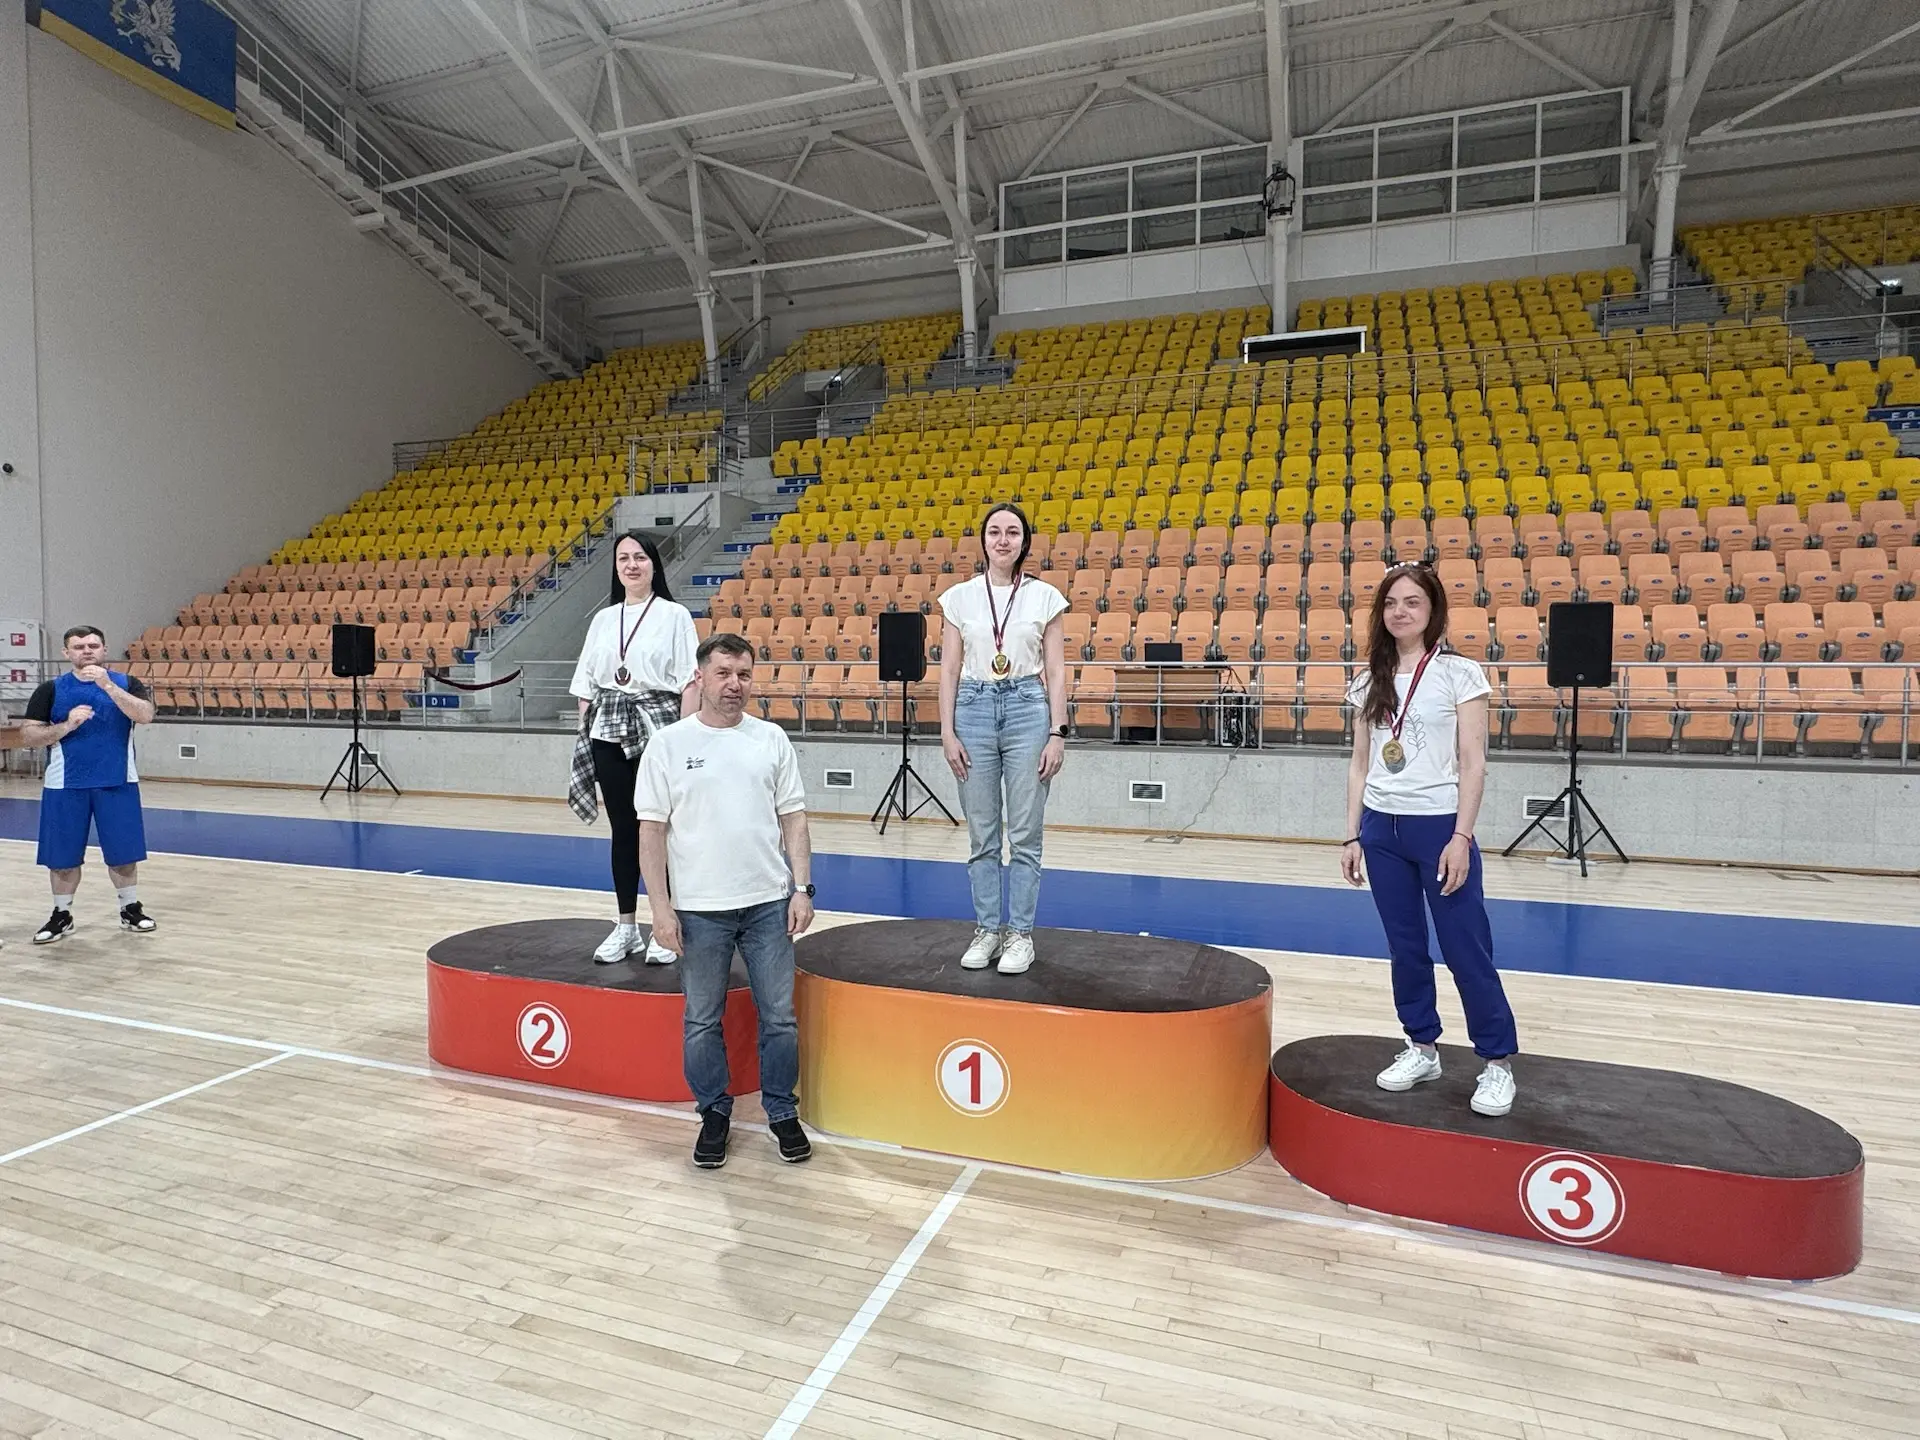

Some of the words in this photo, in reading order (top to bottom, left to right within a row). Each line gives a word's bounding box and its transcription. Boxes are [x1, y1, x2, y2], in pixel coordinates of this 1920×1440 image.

[706, 577, 713, 585] E
[715, 577, 721, 585] 4
[431, 697, 438, 706] D
[442, 697, 446, 706] 1
[531, 1012, 556, 1059] 2
[958, 1051, 981, 1104] 1
[1547, 1167, 1595, 1231] 3
